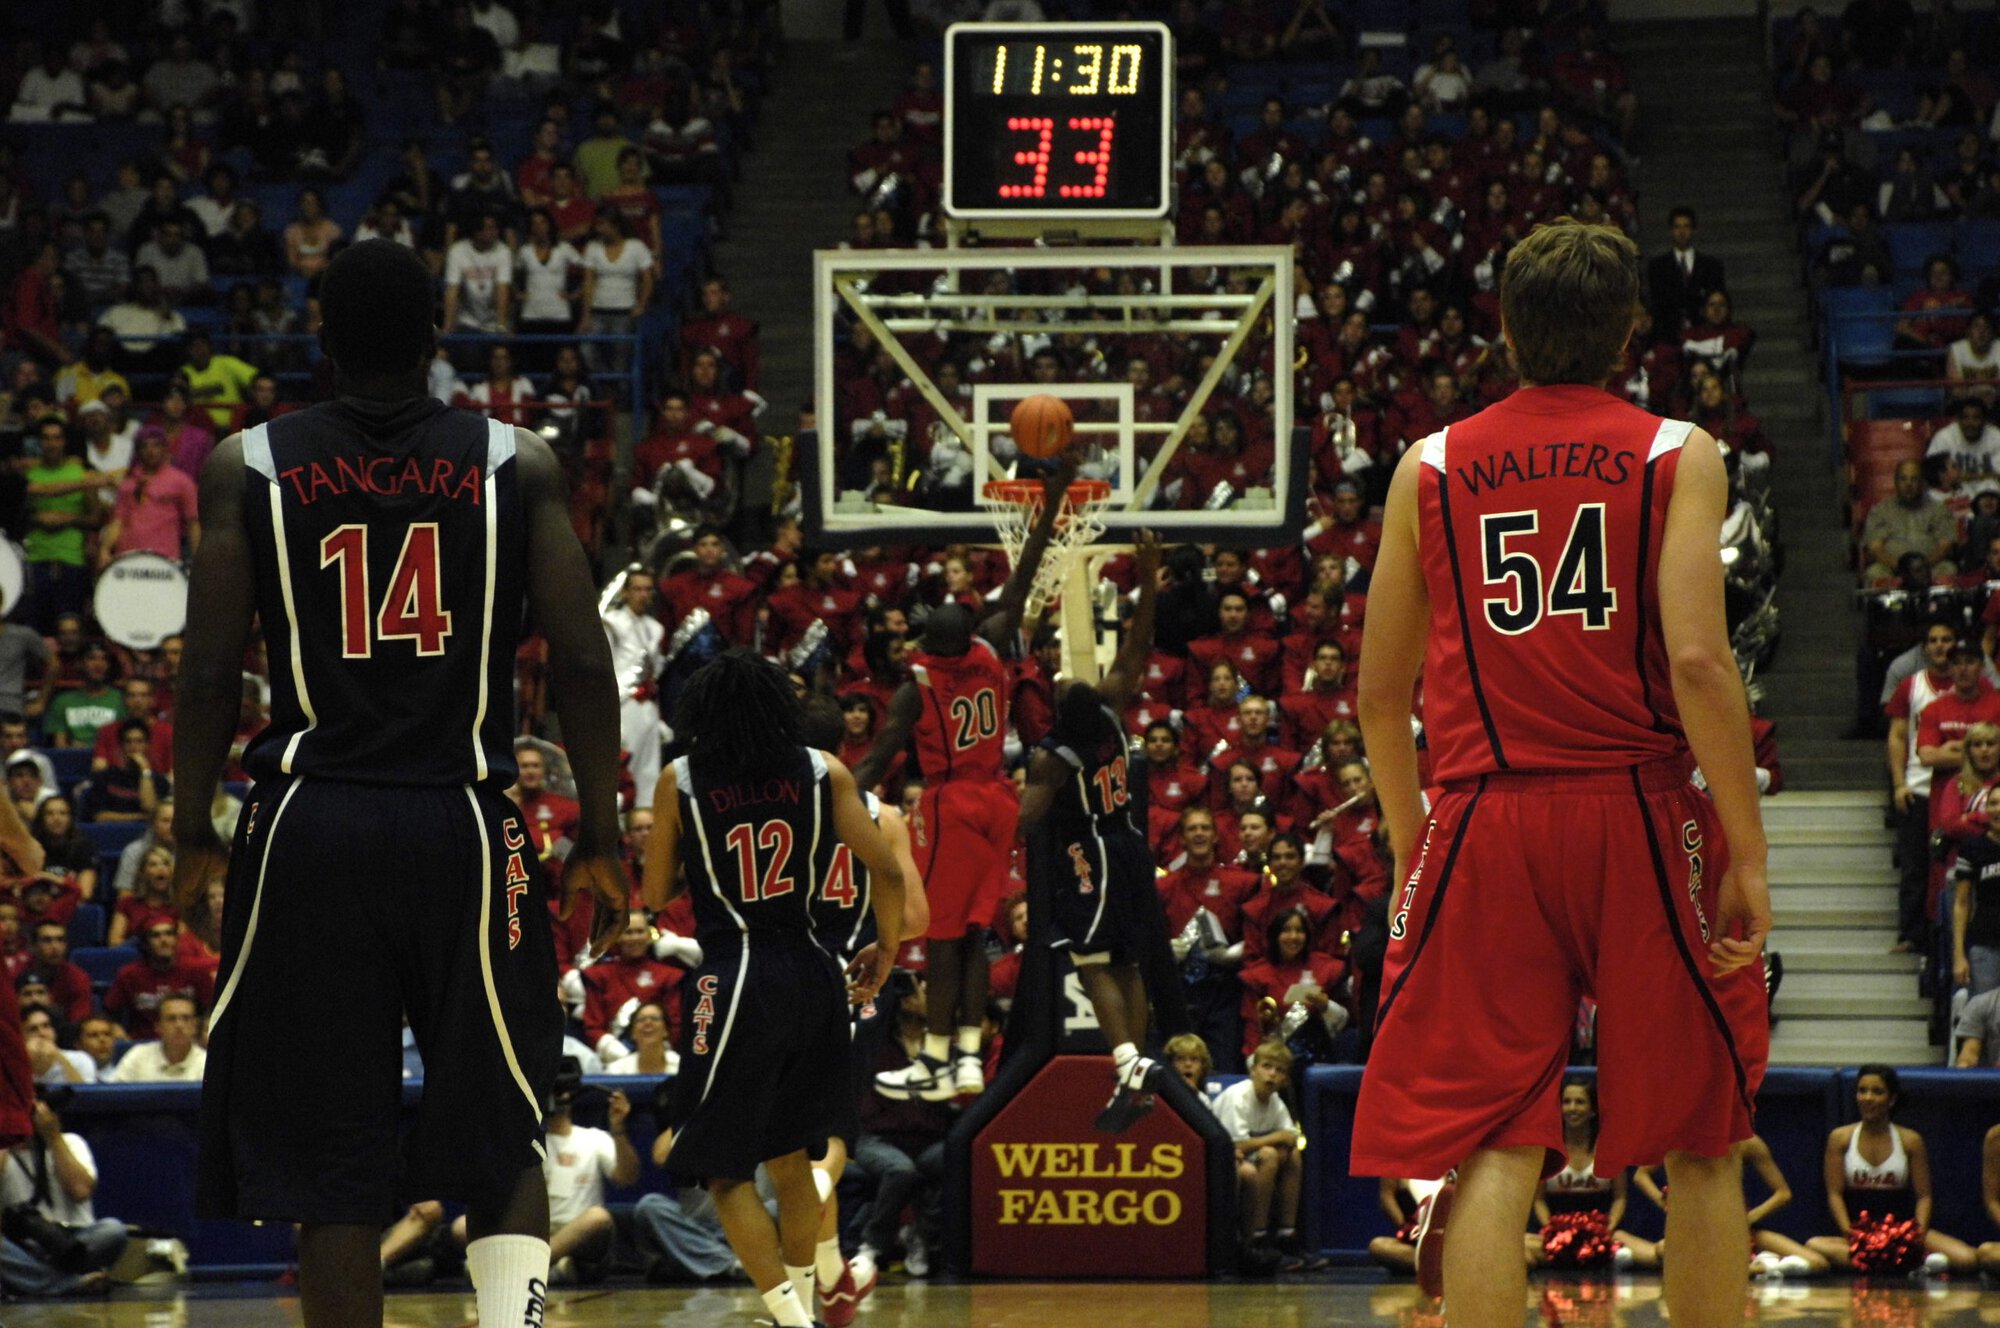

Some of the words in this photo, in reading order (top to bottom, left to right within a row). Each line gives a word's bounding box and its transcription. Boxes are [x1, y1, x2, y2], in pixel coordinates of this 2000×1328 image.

[993, 45, 1142, 95] 11:30
[999, 117, 1115, 198] 33
[279, 455, 481, 506] TANGARA
[1457, 442, 1635, 496] WALTERS
[320, 521, 453, 659] 14
[1480, 502, 1618, 636] 54
[951, 687, 998, 752] 20
[708, 778, 800, 814] DILLON
[1093, 755, 1128, 816] 13
[503, 817, 529, 951] CATS
[725, 818, 795, 903] 12
[693, 974, 719, 1055] CATS
[990, 1142, 1185, 1179] WELLS
[997, 1188, 1183, 1226] FARGO
